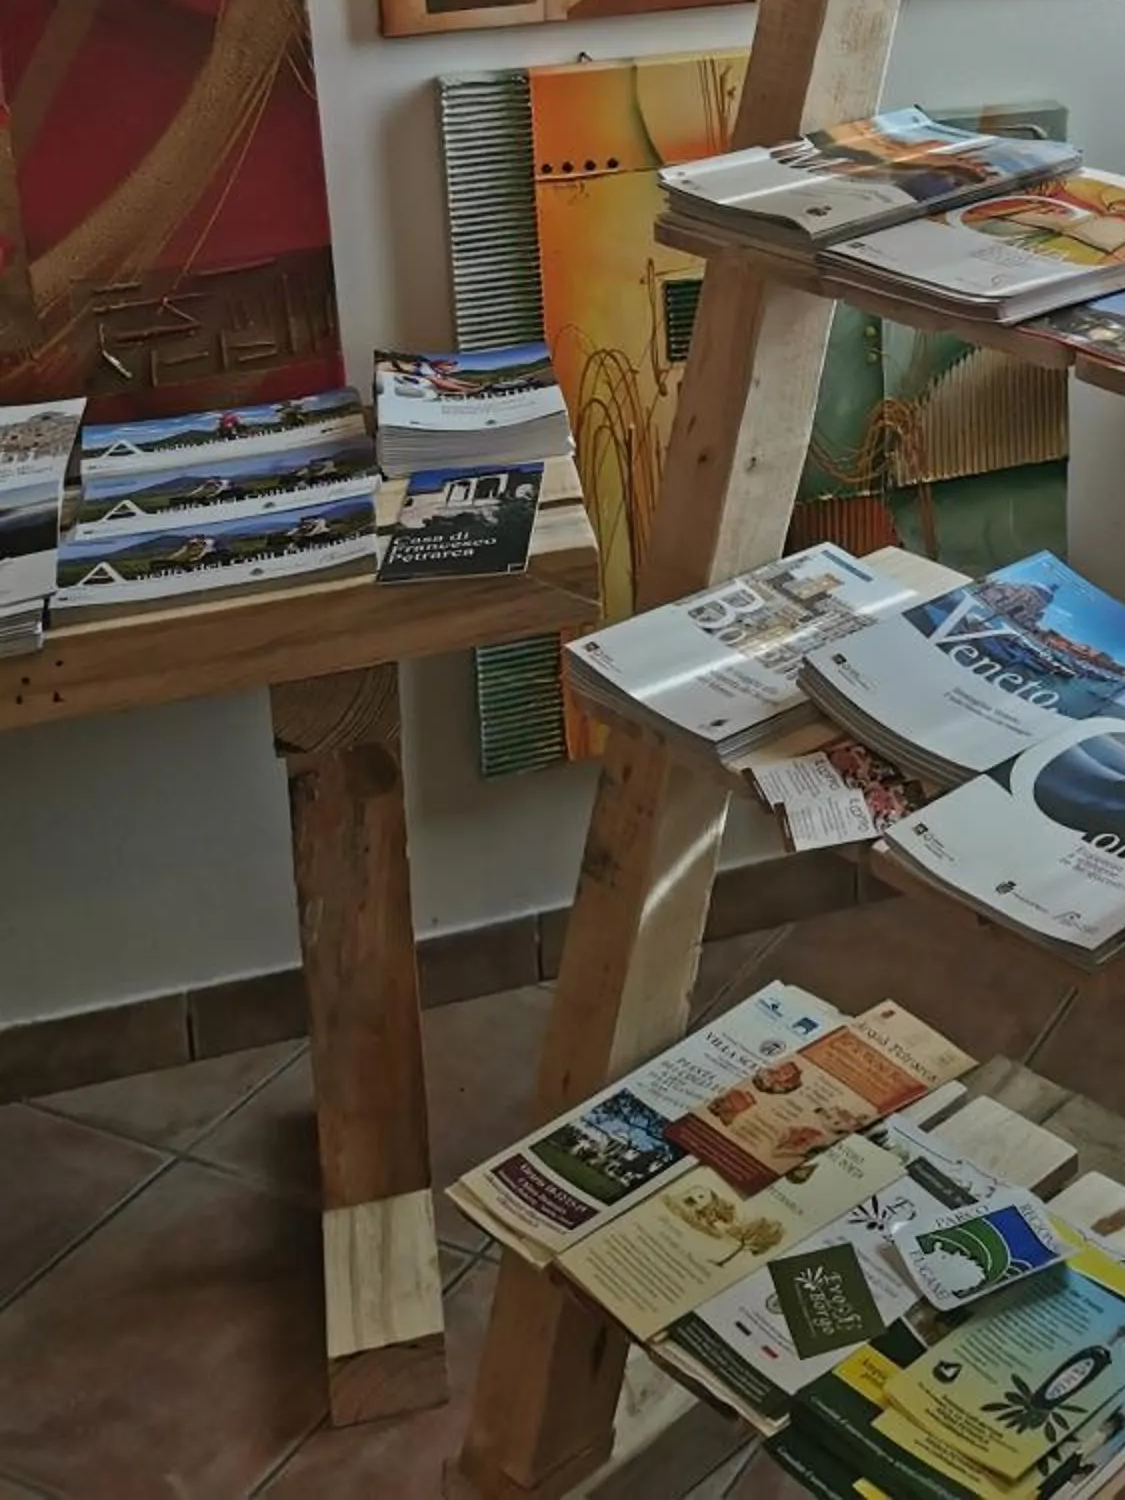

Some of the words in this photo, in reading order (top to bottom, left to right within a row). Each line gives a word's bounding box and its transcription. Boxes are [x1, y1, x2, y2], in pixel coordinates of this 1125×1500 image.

[450, 531, 469, 542] di
[391, 537, 497, 553] Francesco
[389, 547, 475, 564] Petrarca
[935, 1204, 990, 1229] PARCO
